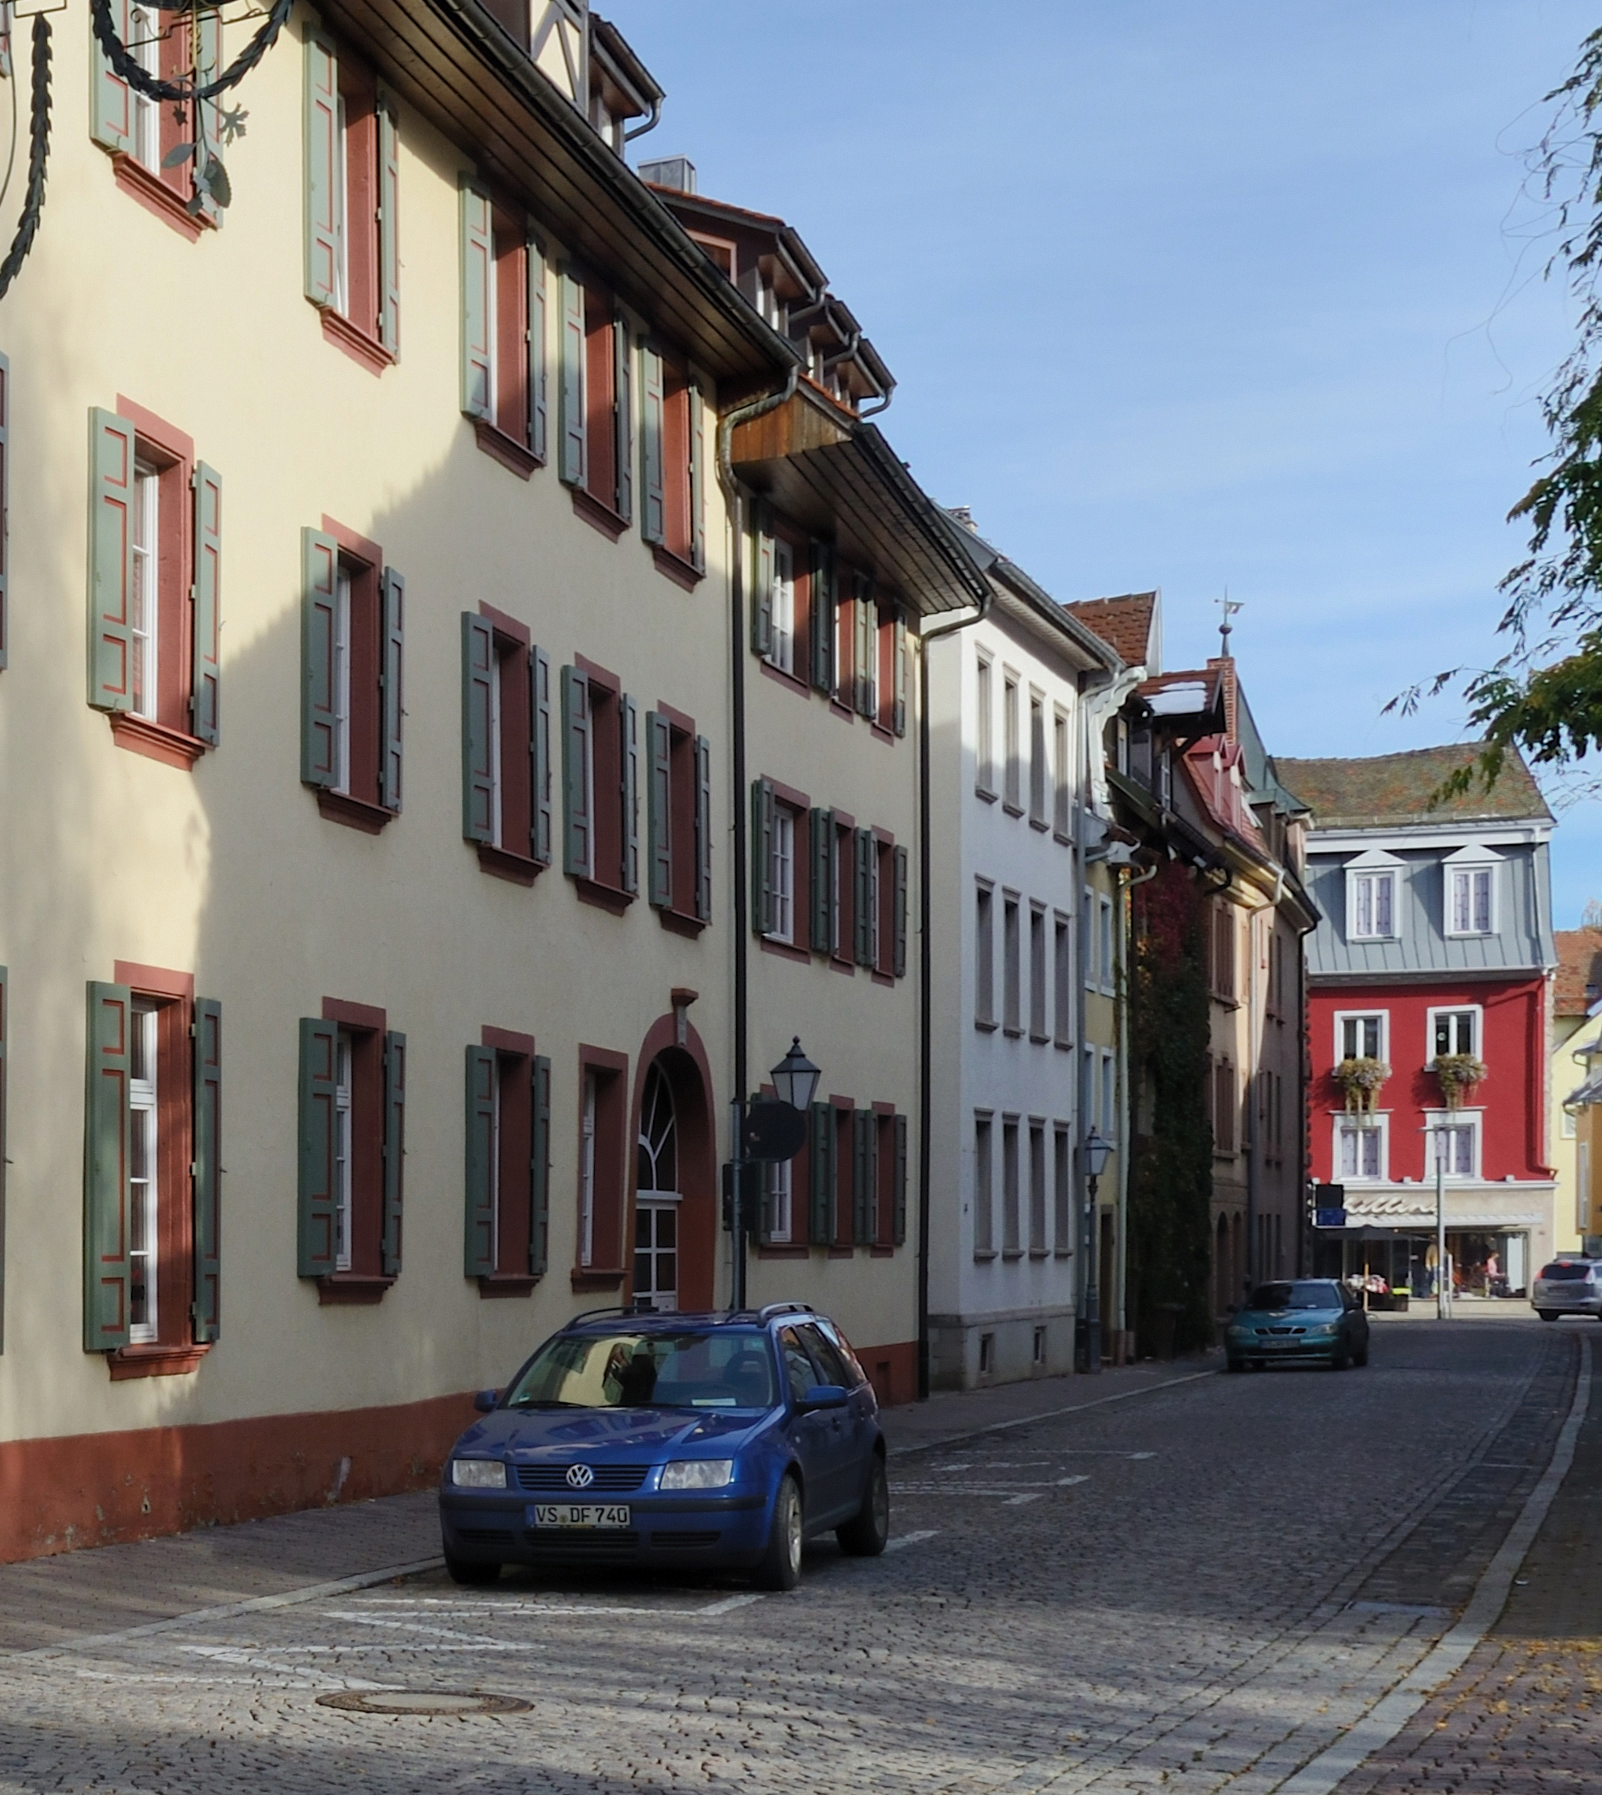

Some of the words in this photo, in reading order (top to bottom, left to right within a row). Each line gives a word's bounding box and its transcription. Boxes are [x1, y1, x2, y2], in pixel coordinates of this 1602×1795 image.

[536, 1507, 558, 1523] VS
[570, 1507, 591, 1523] DF
[595, 1507, 628, 1523] 740
